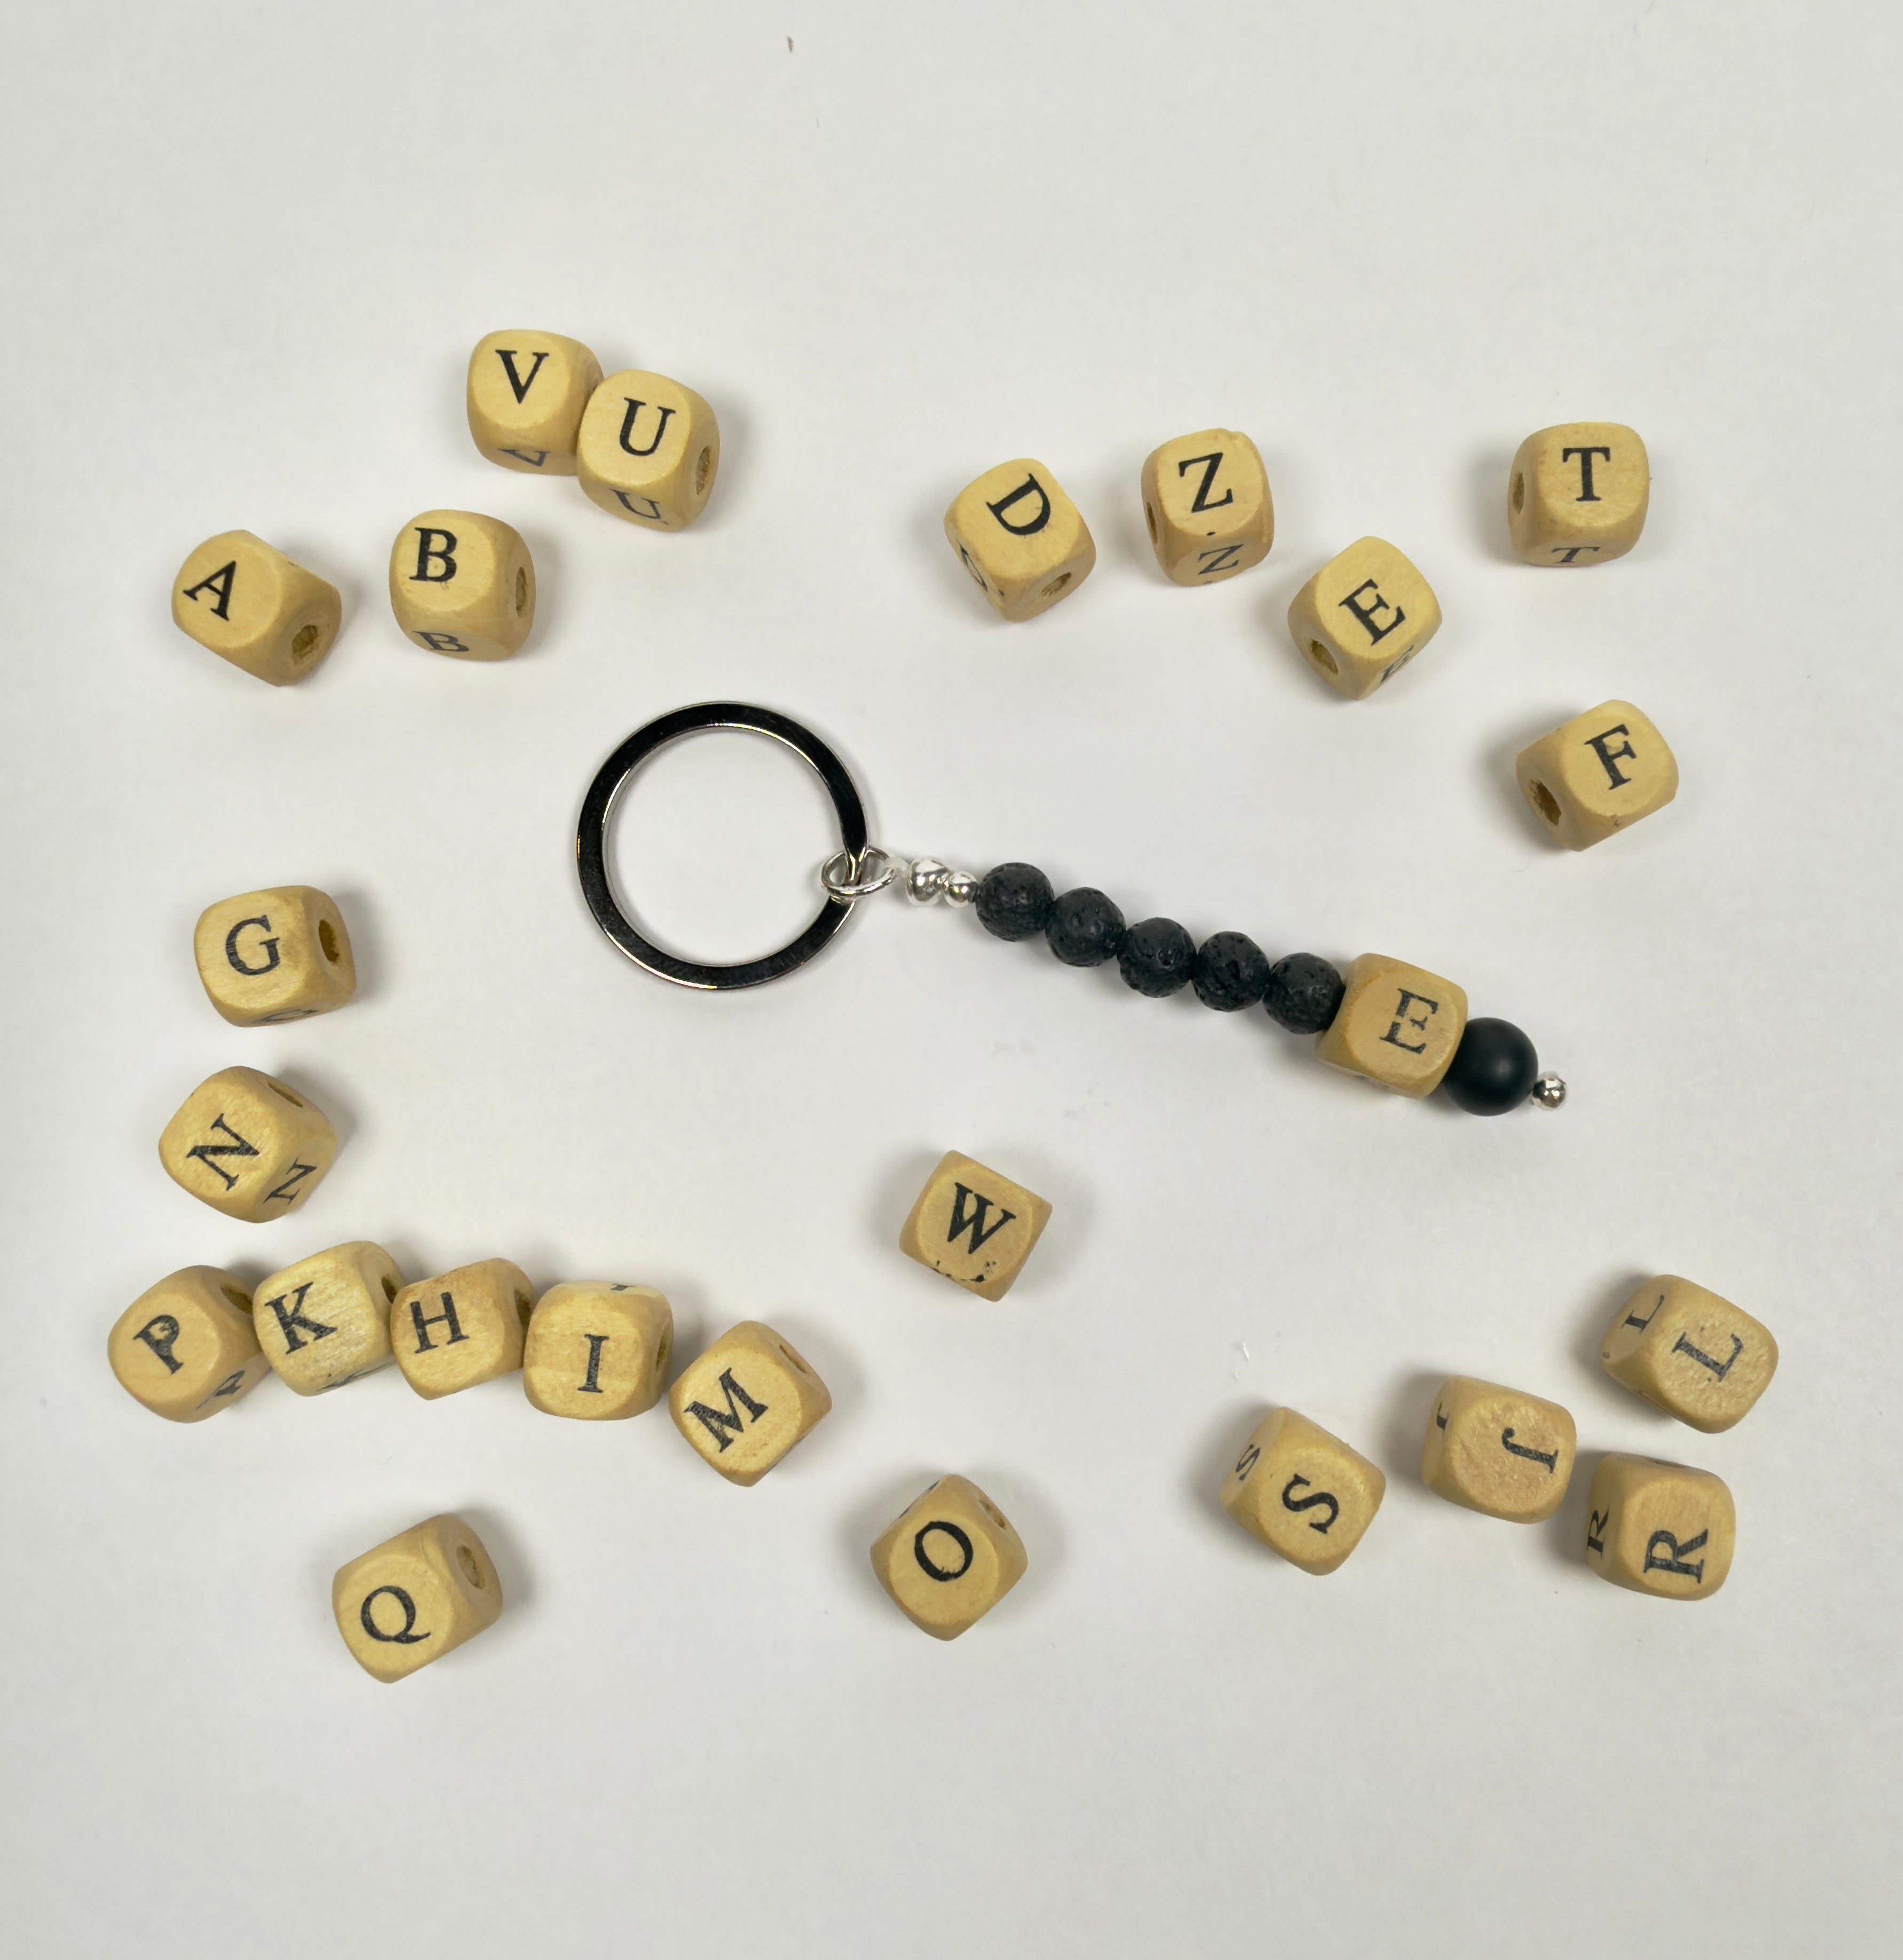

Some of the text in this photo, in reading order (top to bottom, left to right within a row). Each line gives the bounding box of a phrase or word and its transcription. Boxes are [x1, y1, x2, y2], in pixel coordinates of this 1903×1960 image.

[495, 349, 550, 404] V
[620, 397, 677, 457] U
[986, 474, 1051, 535] D
[1179, 452, 1233, 513] Z
[1562, 447, 1611, 502] T
[410, 527, 458, 583] B
[183, 561, 236, 620] A
[1340, 579, 1406, 645] E
[1585, 724, 1636, 791] F
[226, 915, 280, 976] G
[1379, 988, 1439, 1055] E
[186, 1113, 260, 1191] N
[947, 1182, 1016, 1255] W
[133, 1315, 183, 1375] P
[264, 1282, 338, 1354] K
[410, 1292, 469, 1354] H
[578, 1334, 609, 1393] I
[1672, 1332, 1744, 1383] L
[684, 1368, 768, 1453] M
[1501, 1427, 1558, 1473] J
[1282, 1473, 1339, 1534] S
[914, 1521, 974, 1582] O
[1643, 1529, 1709, 1584] R
[361, 1586, 431, 1644] Q
